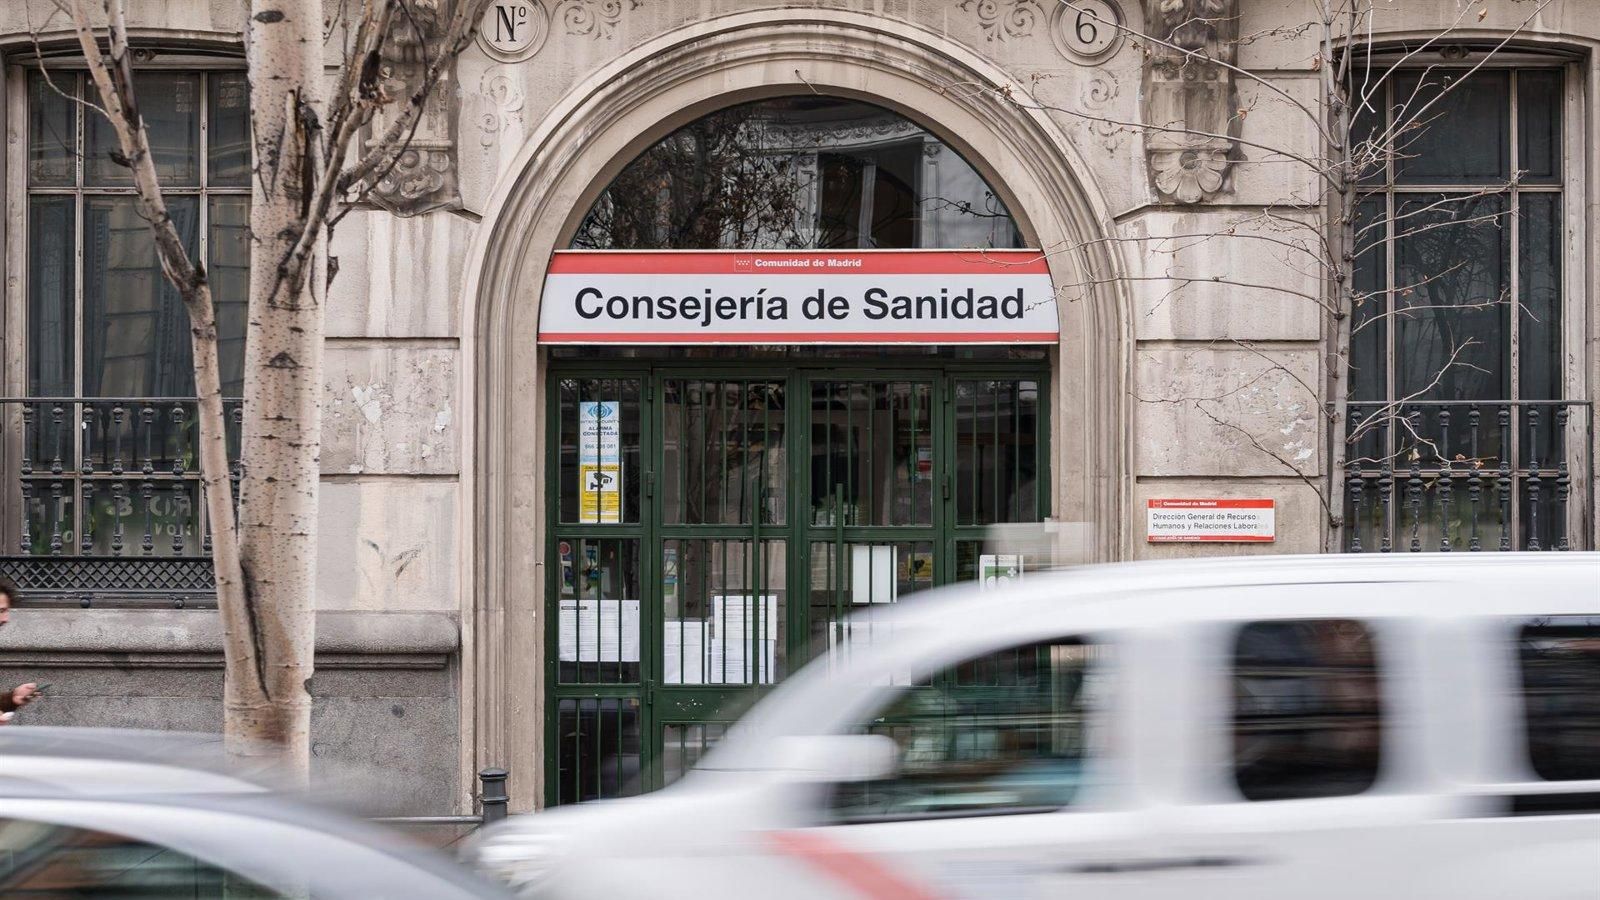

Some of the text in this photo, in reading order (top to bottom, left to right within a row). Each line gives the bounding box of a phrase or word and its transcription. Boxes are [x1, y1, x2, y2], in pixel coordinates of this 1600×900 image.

[755, 258, 862, 268] Comunidad de Madrid
[574, 287, 1025, 327] Consejería de Sanidad
[1152, 512, 1186, 520] Dirección
[1187, 512, 1215, 520] General
[1216, 512, 1225, 520] de
[1152, 522, 1186, 530] Humanos
[1187, 523, 1192, 531] y
[1194, 522, 1232, 530] Relaciones
